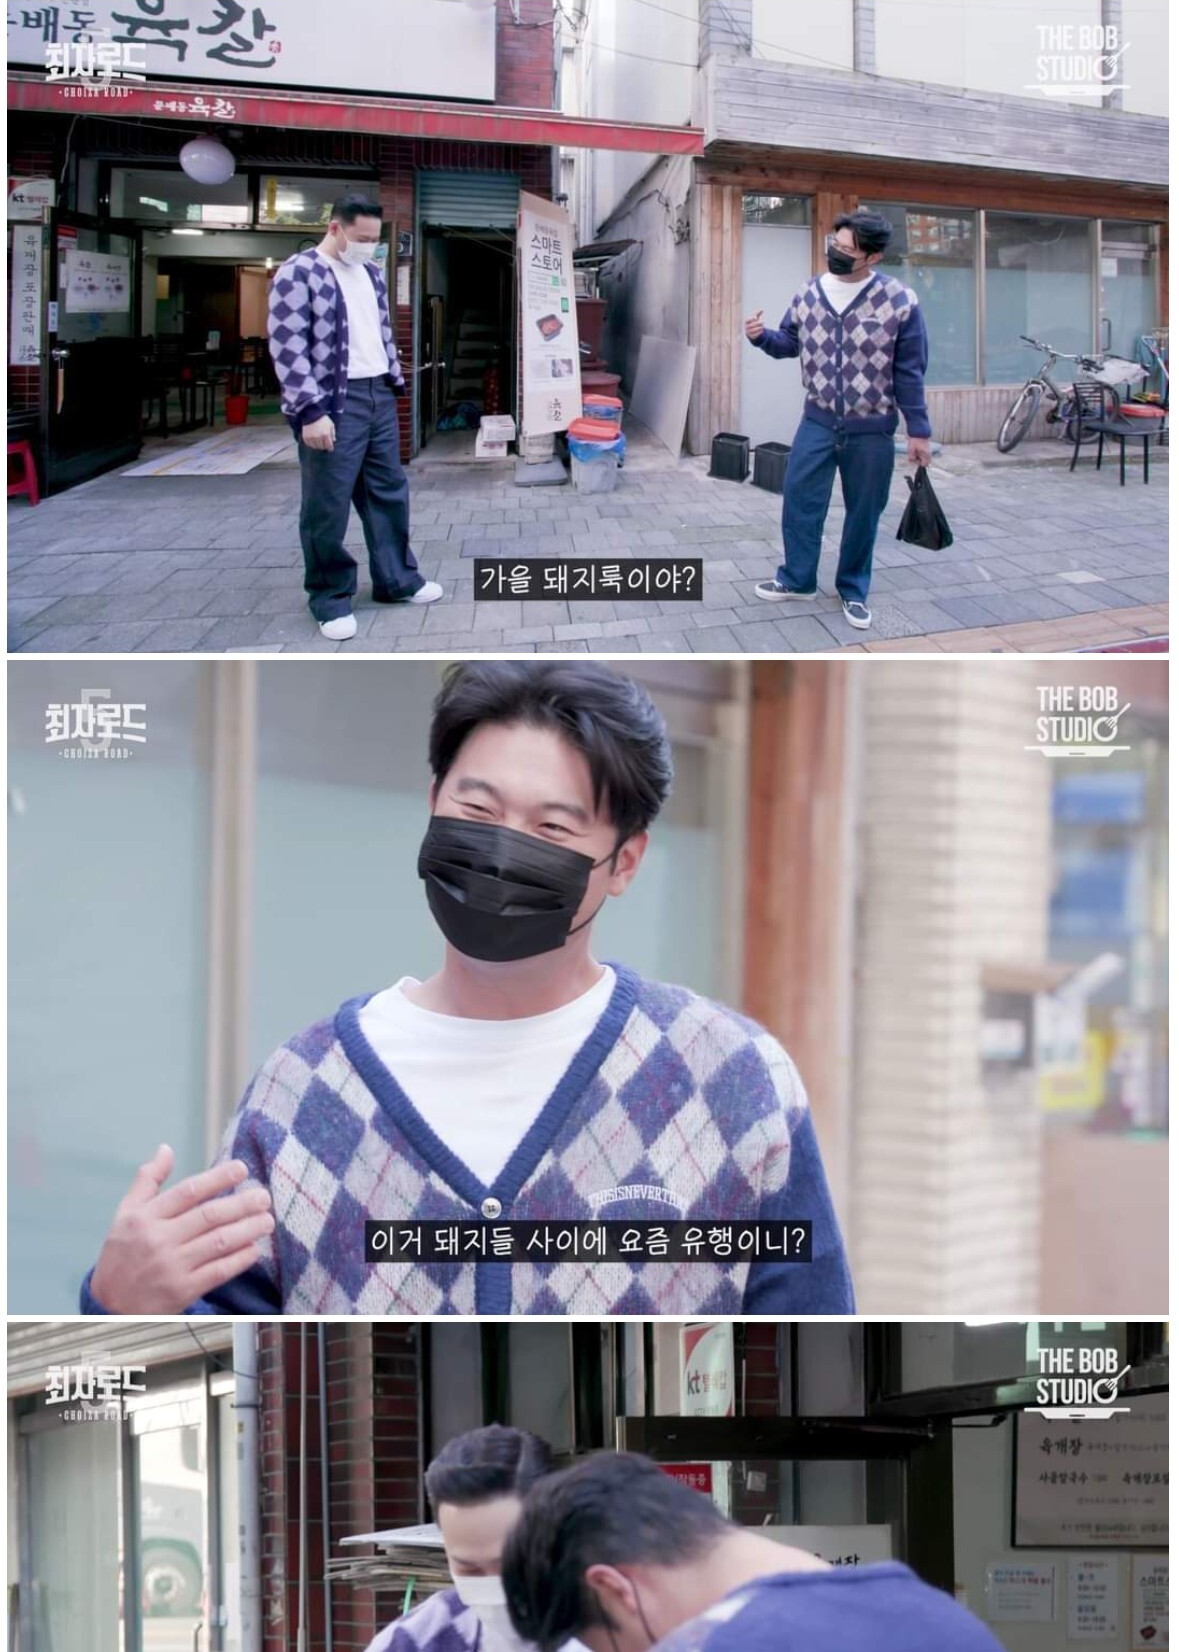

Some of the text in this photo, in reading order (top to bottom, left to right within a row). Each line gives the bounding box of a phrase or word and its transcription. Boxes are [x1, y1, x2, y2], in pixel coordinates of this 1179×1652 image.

[7, 0, 276, 69] 배동 육칼
[531, 236, 563, 255] 스마트
[531, 254, 563, 275] 스토어
[687, 1370, 701, 1396] kt
